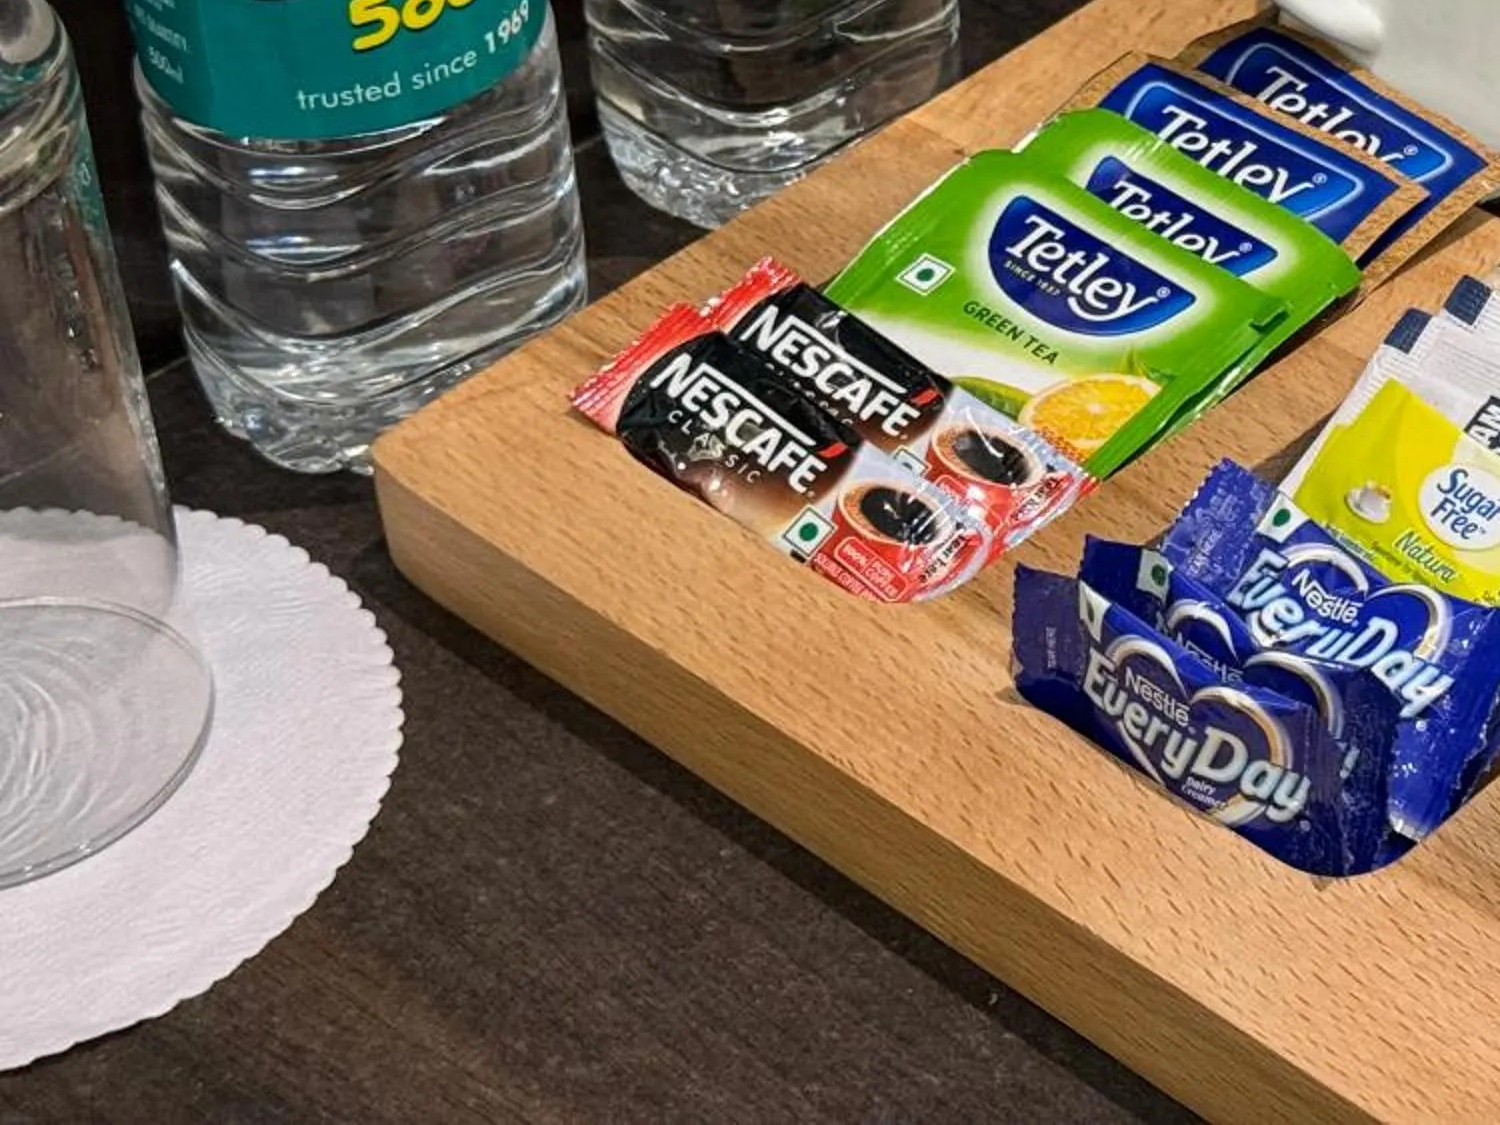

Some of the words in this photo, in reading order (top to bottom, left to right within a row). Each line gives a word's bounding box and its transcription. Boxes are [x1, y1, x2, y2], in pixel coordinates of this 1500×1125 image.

[296, 73, 401, 111] trusted
[412, 48, 479, 91] since
[1004, 214, 1160, 322] Tetley
[963, 300, 1025, 343] GREEN
[1023, 335, 1060, 365] TEA
[1431, 502, 1481, 540] Free
[1394, 531, 1457, 584] Natura
[1083, 646, 1311, 823] EveryDay
